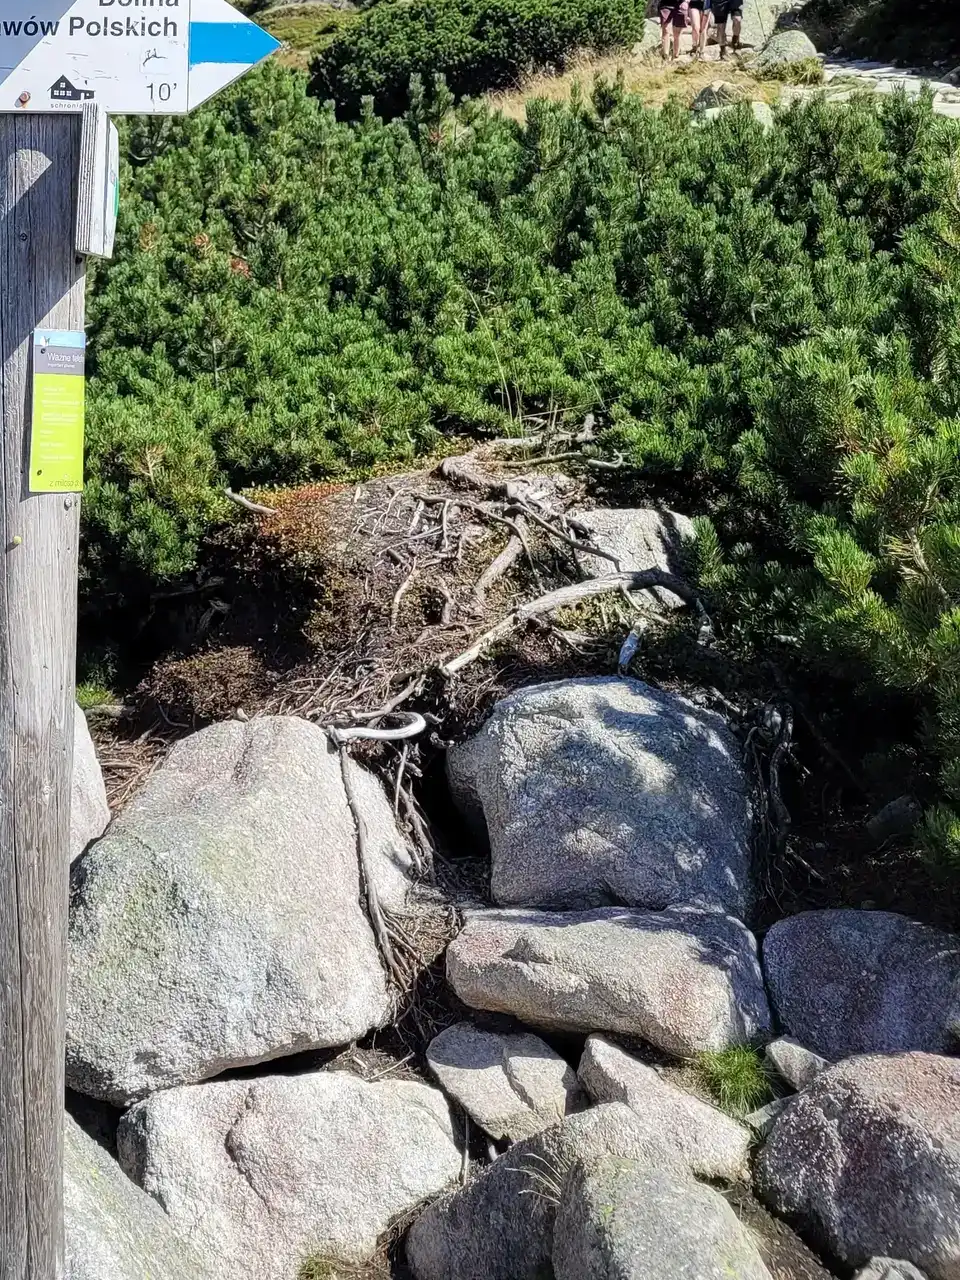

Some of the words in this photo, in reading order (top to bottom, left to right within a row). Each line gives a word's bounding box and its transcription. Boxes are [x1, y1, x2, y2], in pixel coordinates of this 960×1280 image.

[69, 16, 178, 37] Polskich
[146, 82, 177, 101] 10’
[50, 101, 84, 109] schronis
